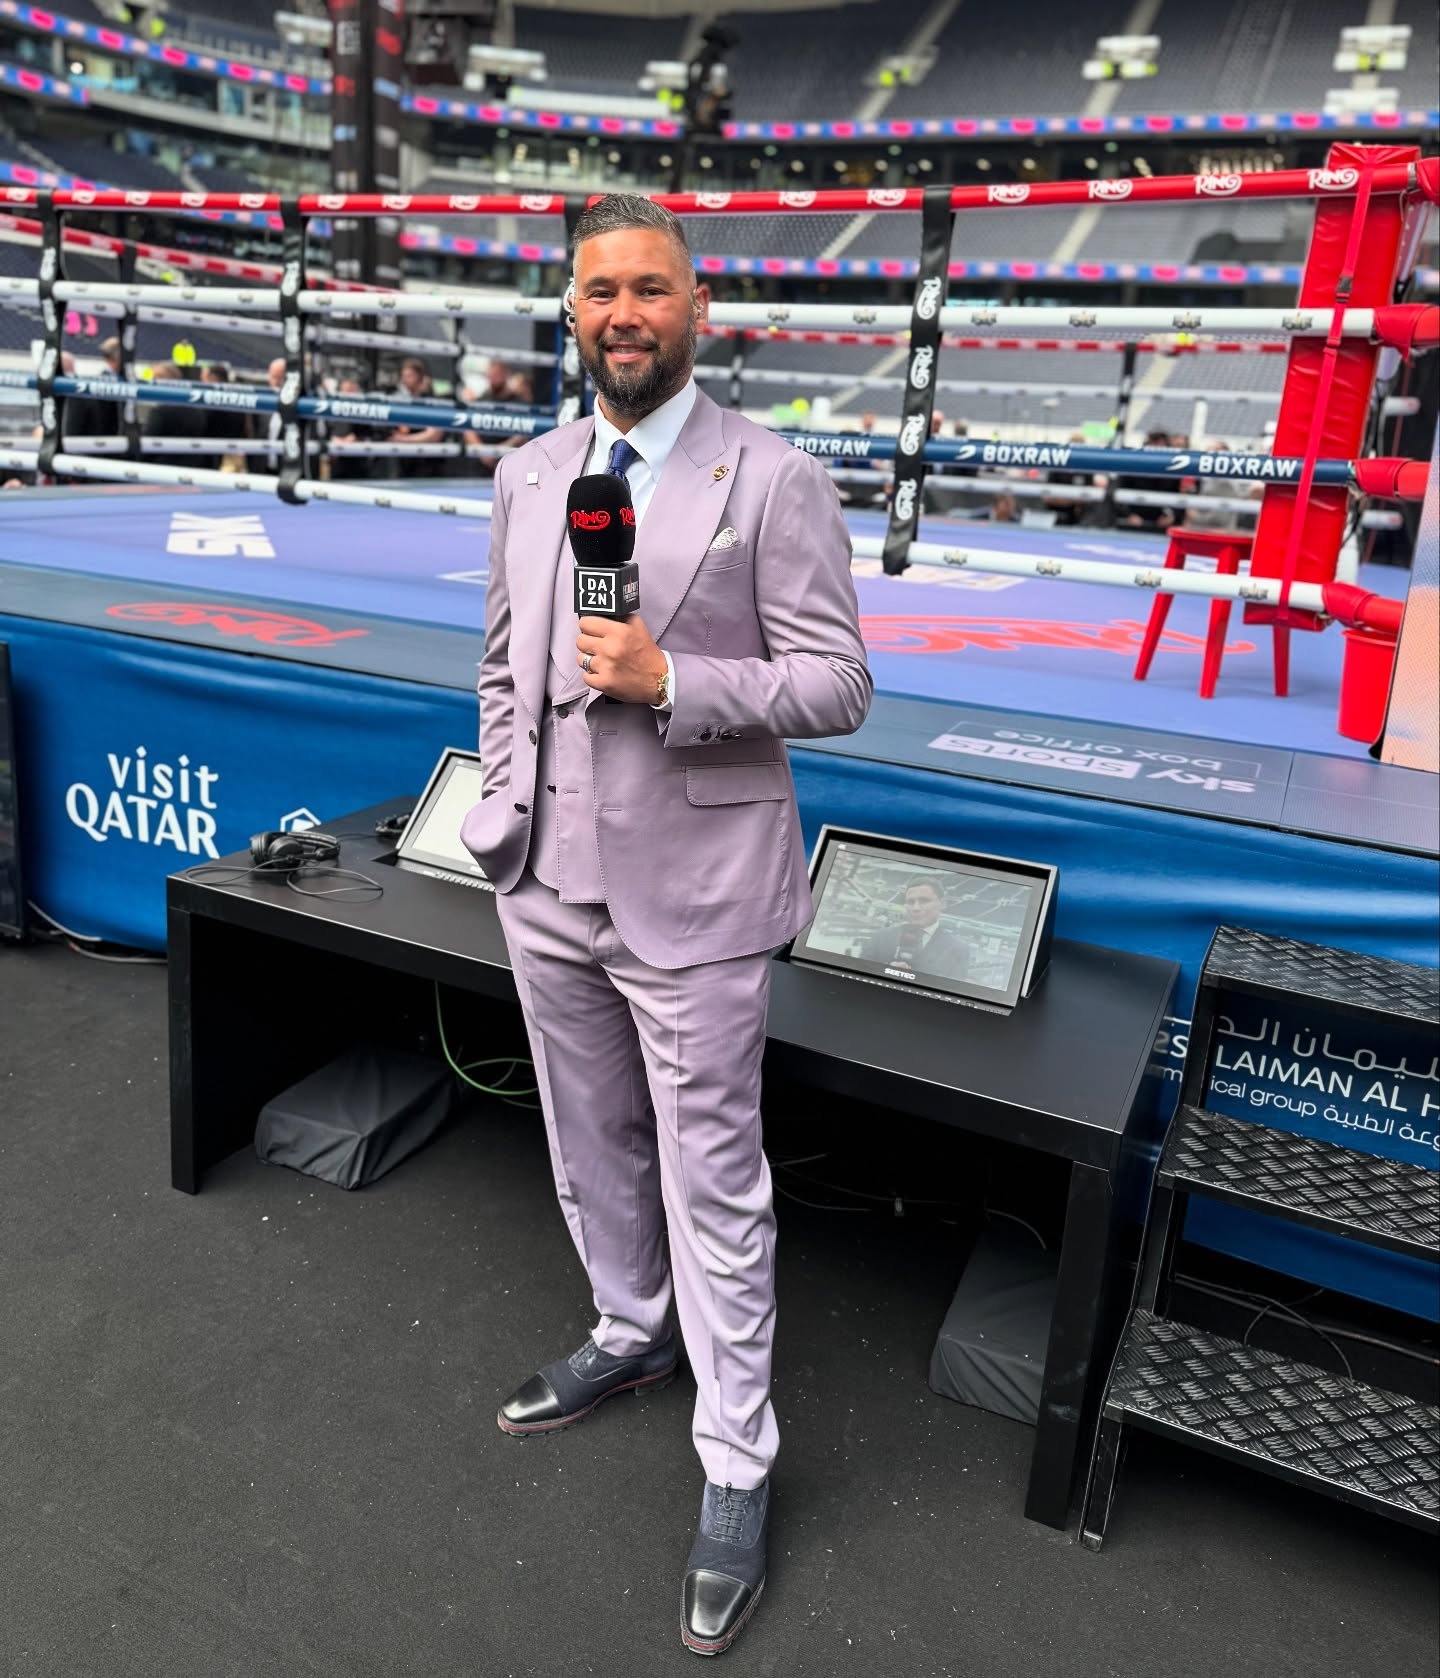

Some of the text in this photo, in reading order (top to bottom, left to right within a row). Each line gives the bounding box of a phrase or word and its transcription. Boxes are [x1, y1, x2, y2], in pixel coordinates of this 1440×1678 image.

[1088, 179, 1133, 200] RING
[1194, 174, 1242, 195] RING
[1307, 168, 1358, 190] RING
[331, 401, 391, 420] BOXRAW
[471, 413, 536, 433] BOXRAW
[794, 437, 871, 456] BOXRAW
[983, 445, 1072, 466] BOXRAW
[1198, 454, 1298, 478] BOXRAW
[619, 507, 636, 526] RIN
[587, 578, 607, 592] DA
[587, 592, 607, 606] ZN
[993, 730, 1222, 772] box office
[107, 745, 219, 809] visit
[1146, 769, 1257, 793] sky
[65, 782, 220, 860] QATAR
[1170, 1035, 1353, 1098] SLAIMAN
[1362, 1081, 1408, 1112] AL
[1250, 1089, 1318, 1116] group
